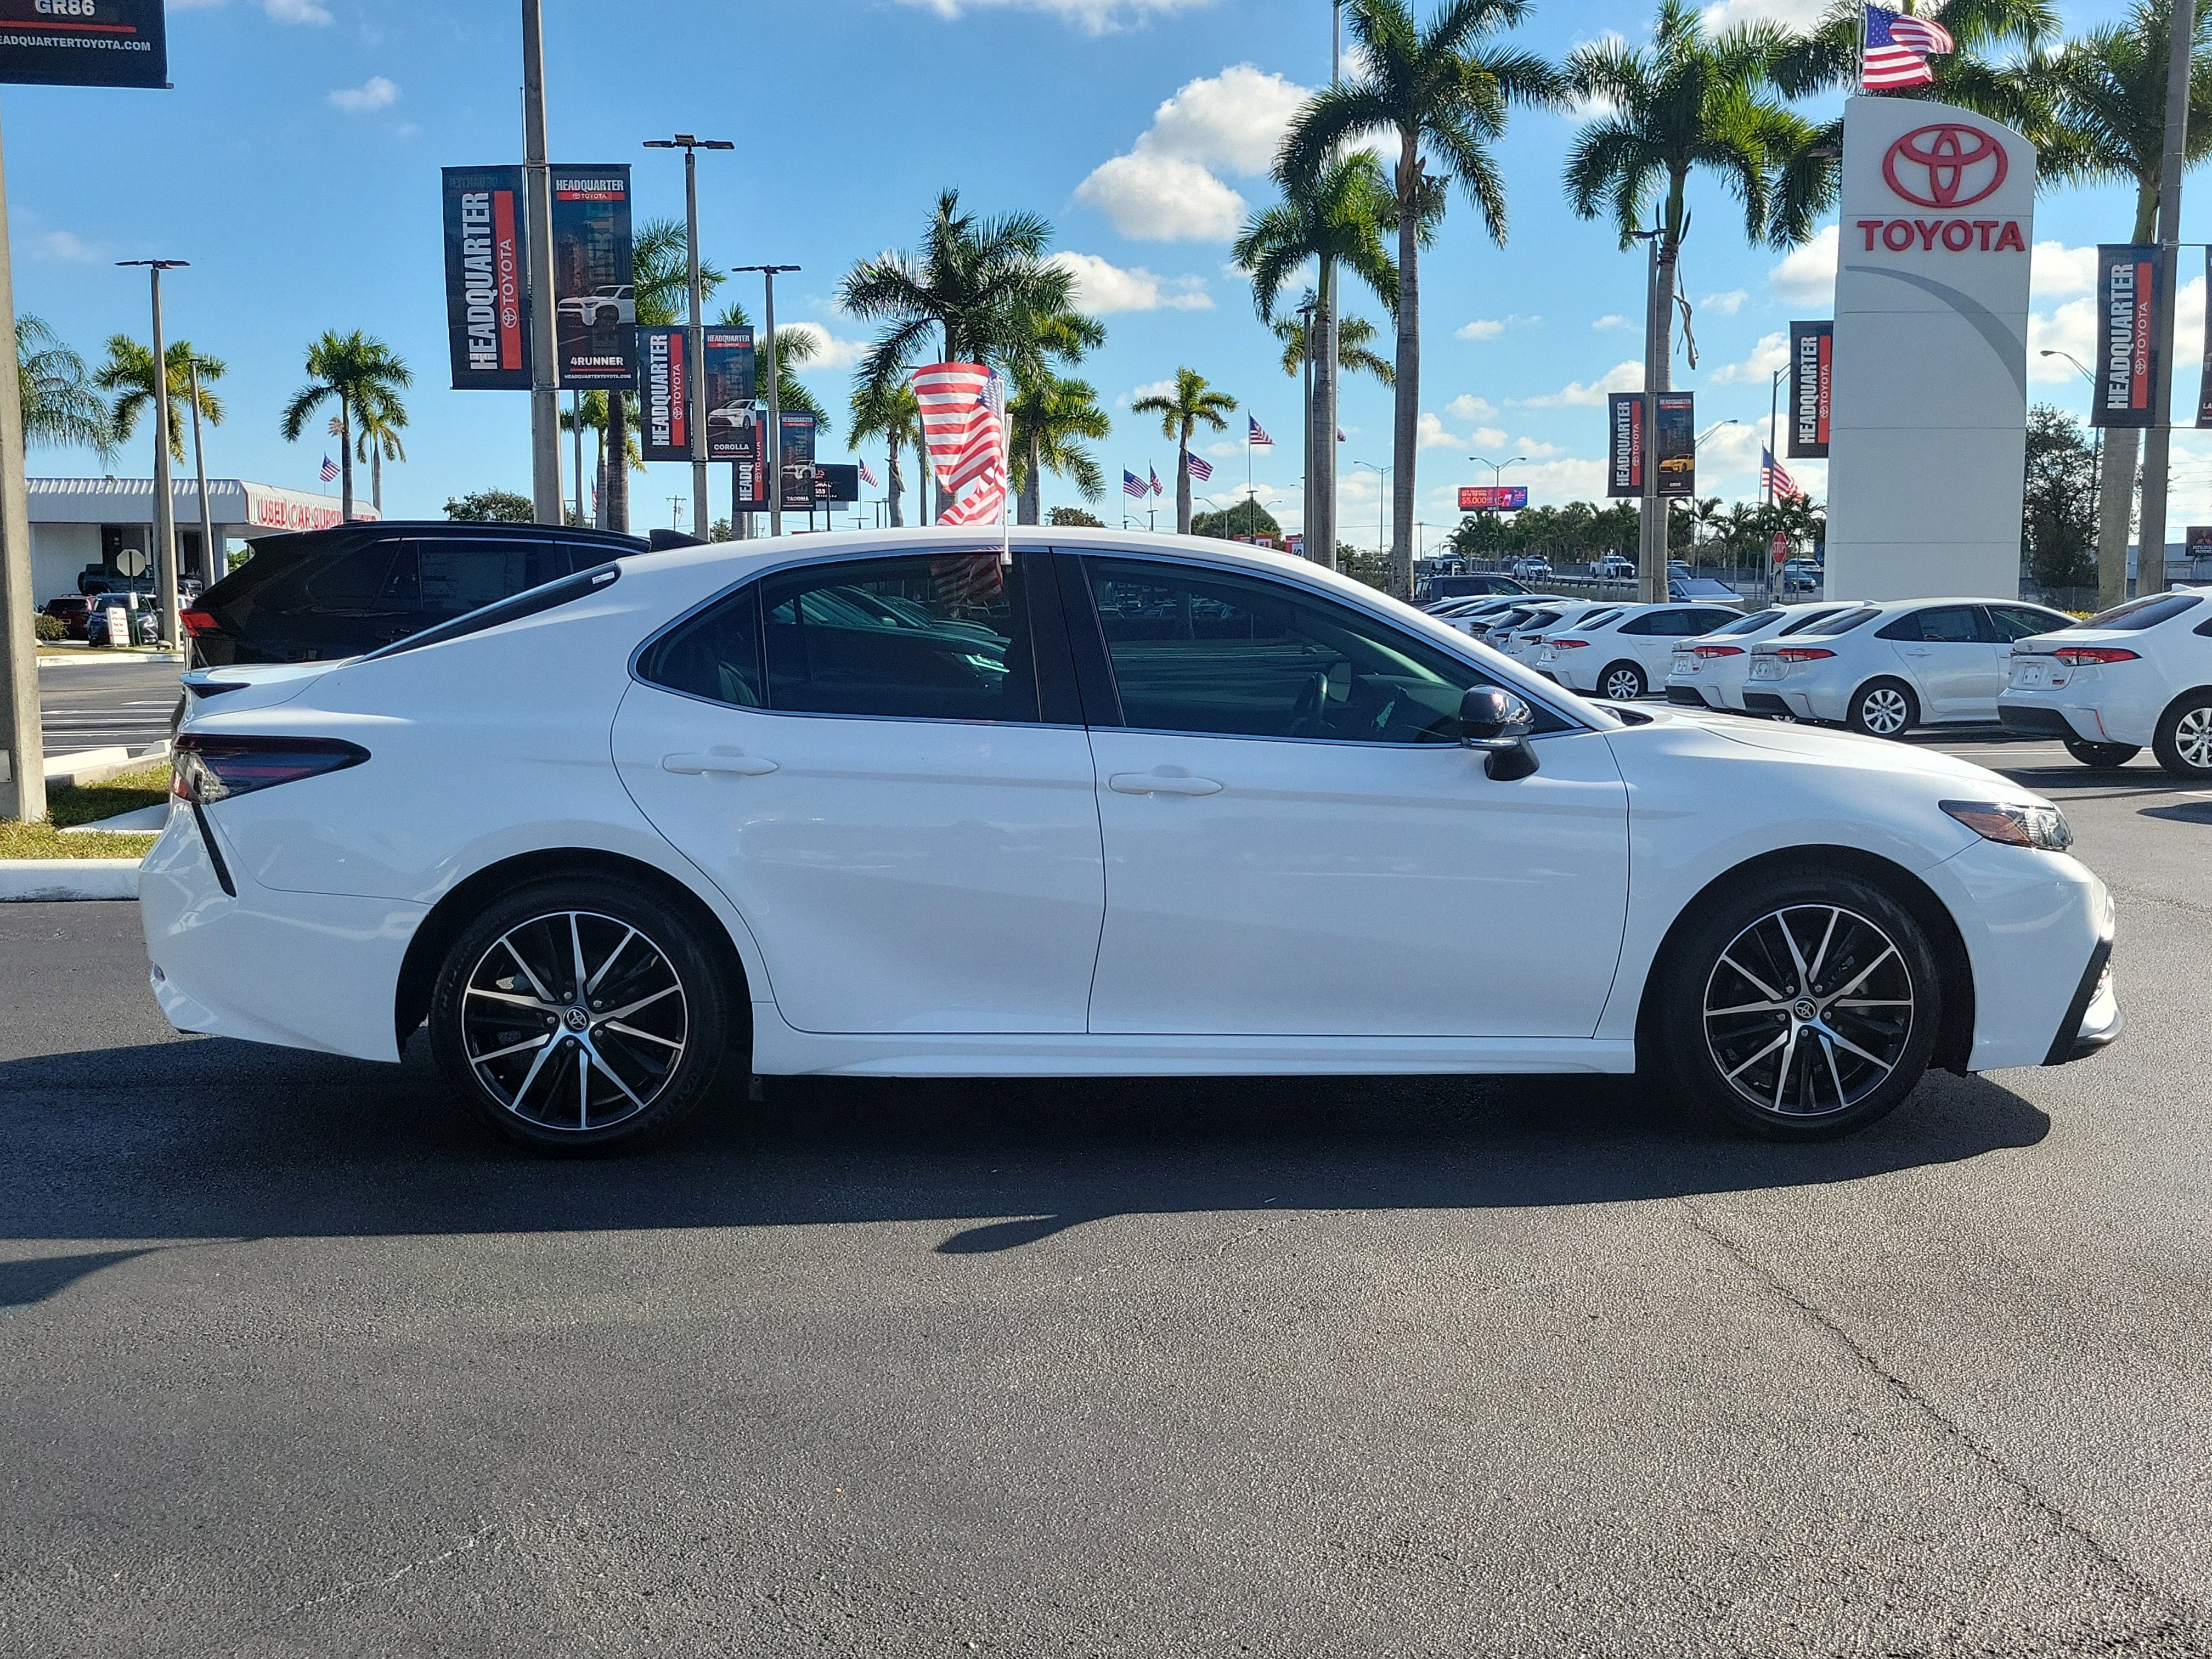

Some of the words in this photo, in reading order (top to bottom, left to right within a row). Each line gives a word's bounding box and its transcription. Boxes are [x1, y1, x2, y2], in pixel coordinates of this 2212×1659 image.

[35, 0, 95, 15] GR86
[556, 179, 624, 192] HEADQUARTER
[1857, 219, 2026, 251] TOYOTA
[462, 192, 498, 370] HEADQUARTER
[499, 239, 515, 306] TOYOTA
[707, 335, 750, 343] HEADQUARTER
[2107, 263, 2135, 409] HEADQUARTER
[2137, 302, 2148, 356] TOYOTA
[571, 357, 624, 366] 4RUNNER
[650, 335, 672, 446] HEADQUARTER
[673, 364, 681, 405] TOYOTA
[1798, 336, 1819, 444] HEADQUARTER
[1820, 364, 1829, 404] TOYOTA
[1616, 402, 1632, 486] HEADQUARTER
[259, 498, 287, 525] USED
[291, 504, 311, 529] CAR
[1773, 541, 1785, 554] STOP
